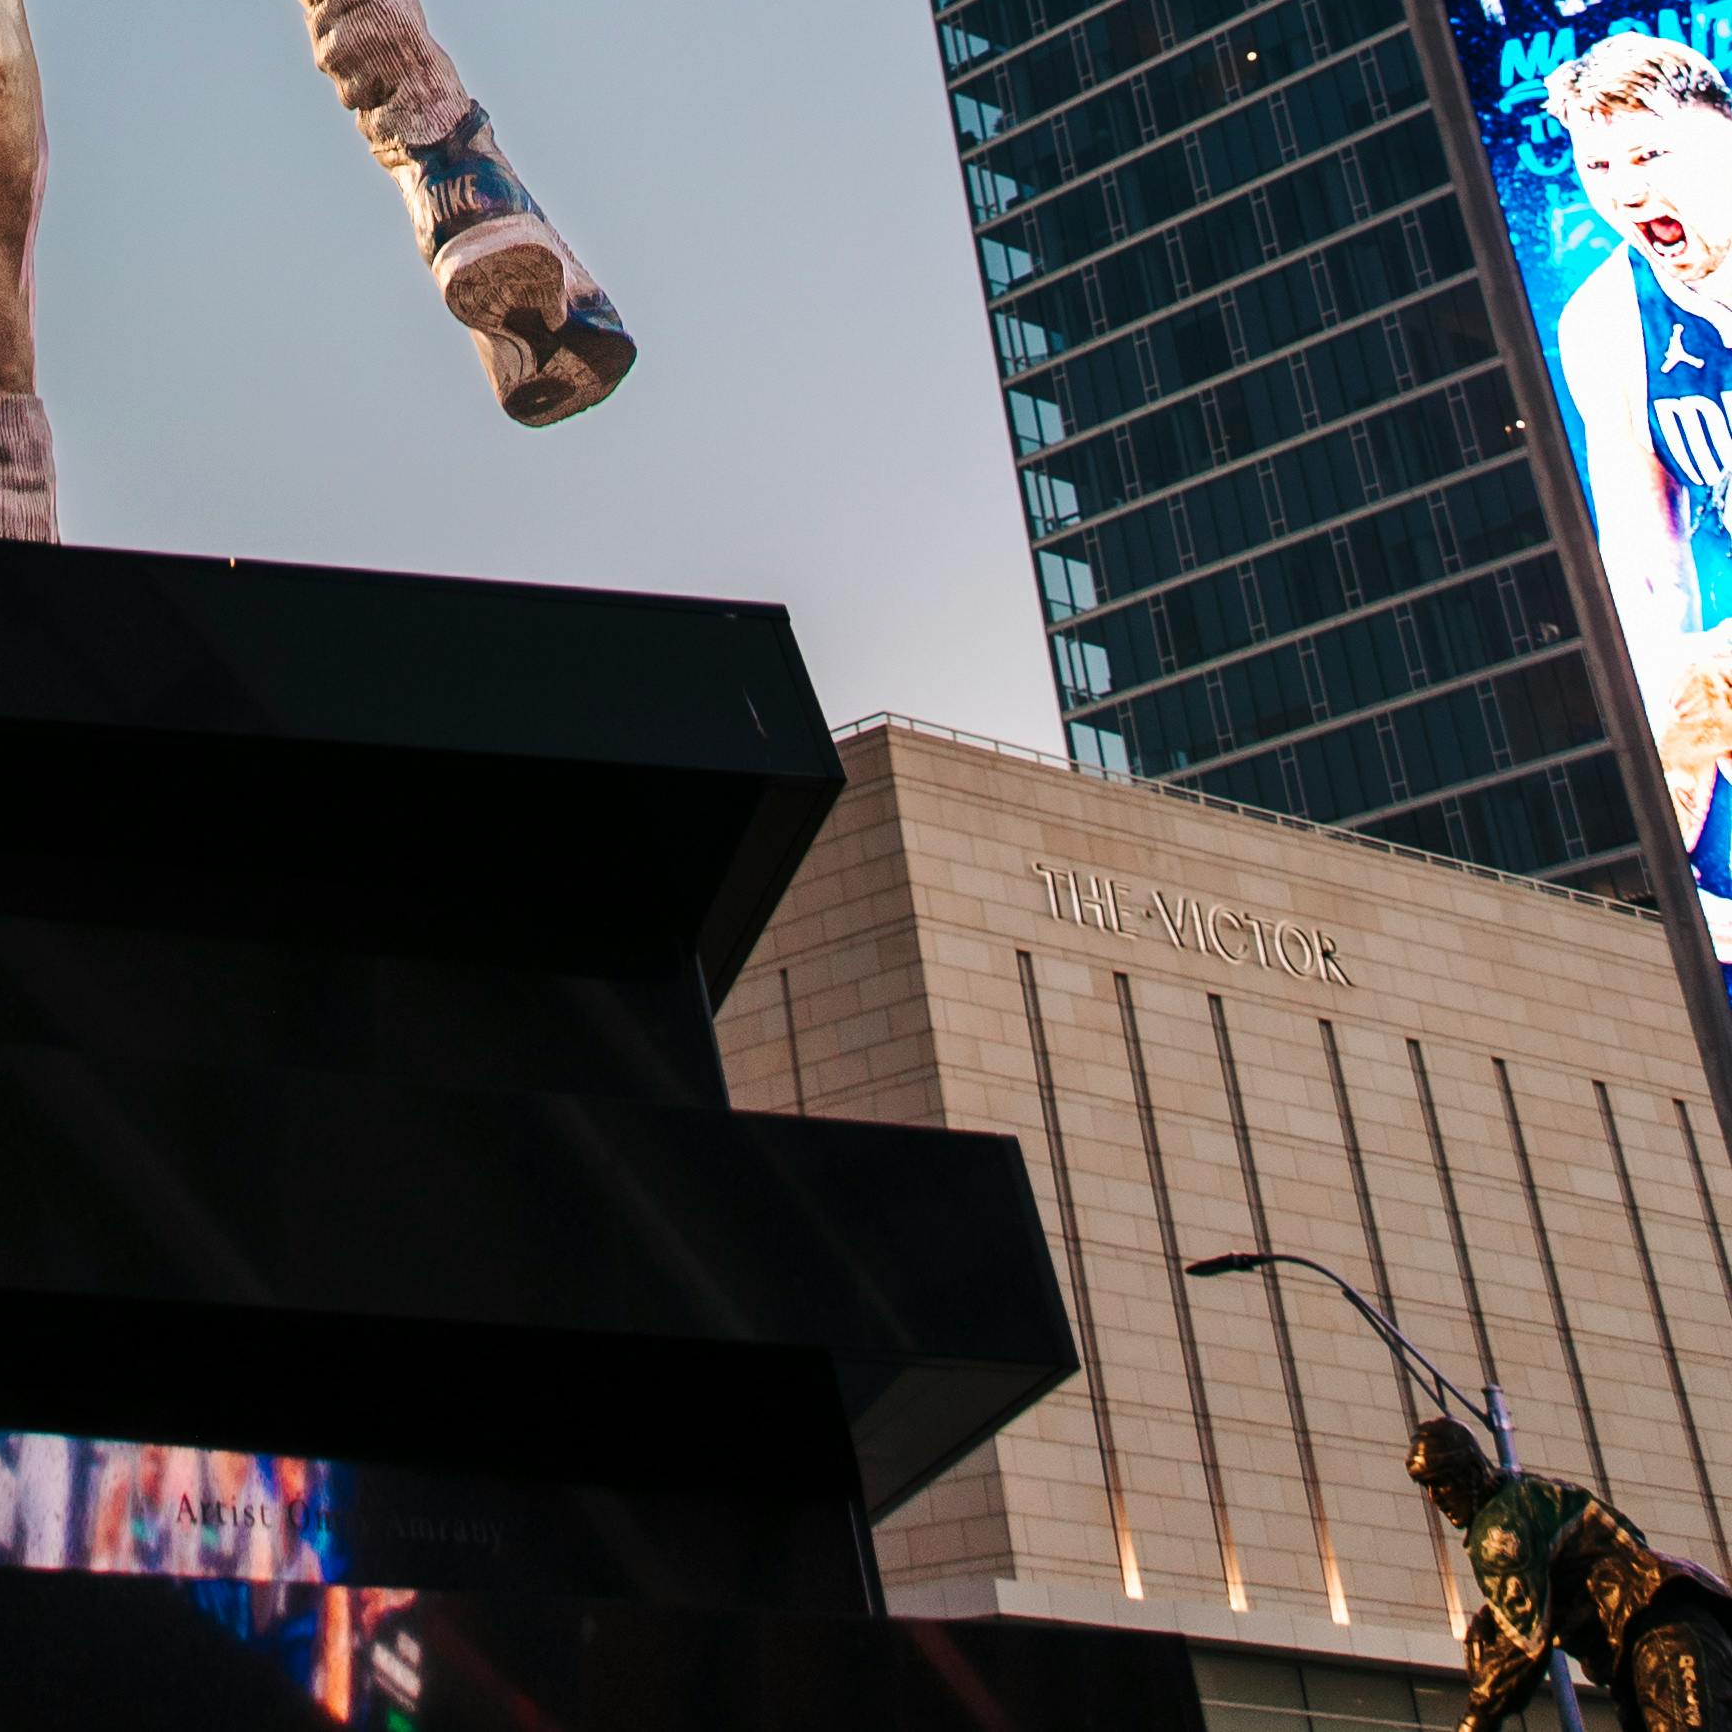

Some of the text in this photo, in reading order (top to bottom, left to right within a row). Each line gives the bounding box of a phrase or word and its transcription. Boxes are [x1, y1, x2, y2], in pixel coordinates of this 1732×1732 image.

[424, 173, 484, 224] NIKE
[1031, 860, 1356, 988] THE VICTOR
[177, 1492, 271, 1529] Artist
